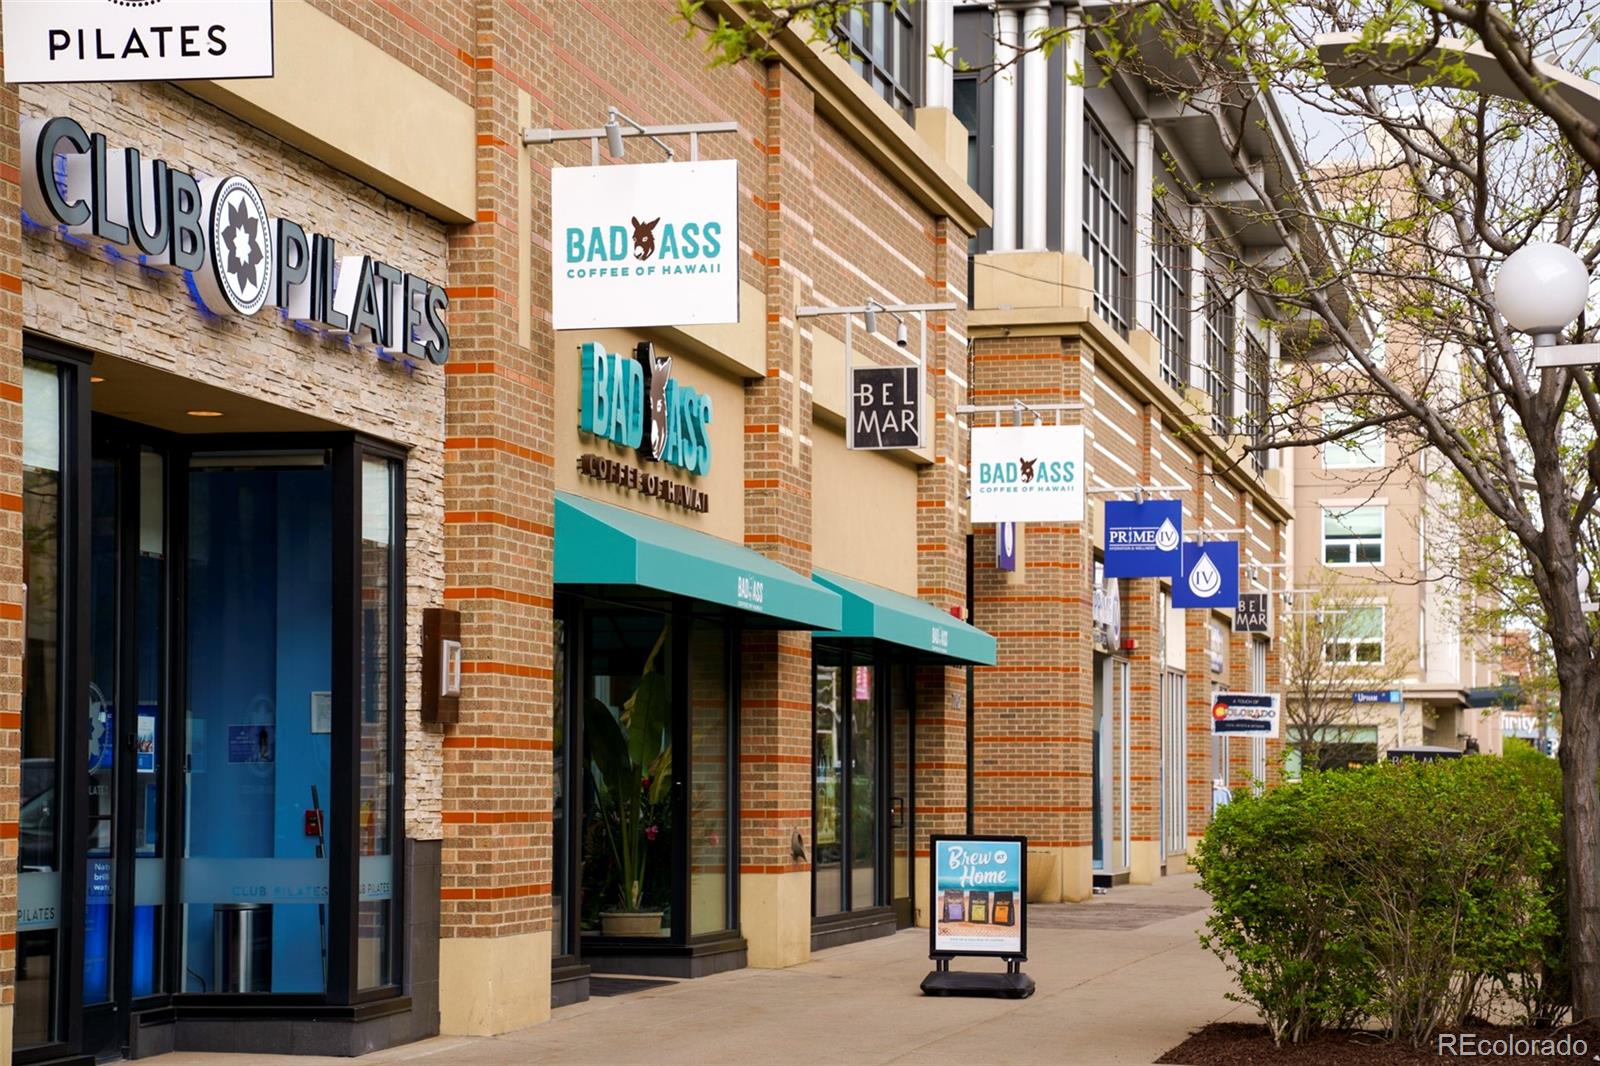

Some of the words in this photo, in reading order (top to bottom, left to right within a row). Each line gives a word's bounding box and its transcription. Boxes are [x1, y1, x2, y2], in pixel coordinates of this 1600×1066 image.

[49, 25, 228, 61] PILATES
[35, 116, 206, 272] CLUB
[276, 218, 450, 366] PILATES
[566, 226, 629, 264] BAD
[658, 221, 721, 260] ASS
[567, 267, 630, 279] COFFEE
[635, 266, 656, 277] OF
[661, 263, 721, 276] HAWAII
[853, 367, 915, 407] BEL
[582, 341, 645, 449] BAD
[664, 377, 712, 478] ASS
[856, 410, 919, 448] MAR
[583, 454, 644, 490] COFFEE
[979, 461, 1018, 484] BAD
[1036, 461, 1075, 483] ASS
[1160, 531, 1174, 542] IV
[1196, 571, 1214, 585] IV
[1238, 594, 1266, 613] BEL
[1236, 612, 1268, 631] MAR
[948, 846, 991, 869] Brew
[960, 866, 1007, 887] Home
[232, 886, 266, 896] CLUB
[273, 886, 329, 897] PILATES
[16, 908, 55, 922] PILATES
